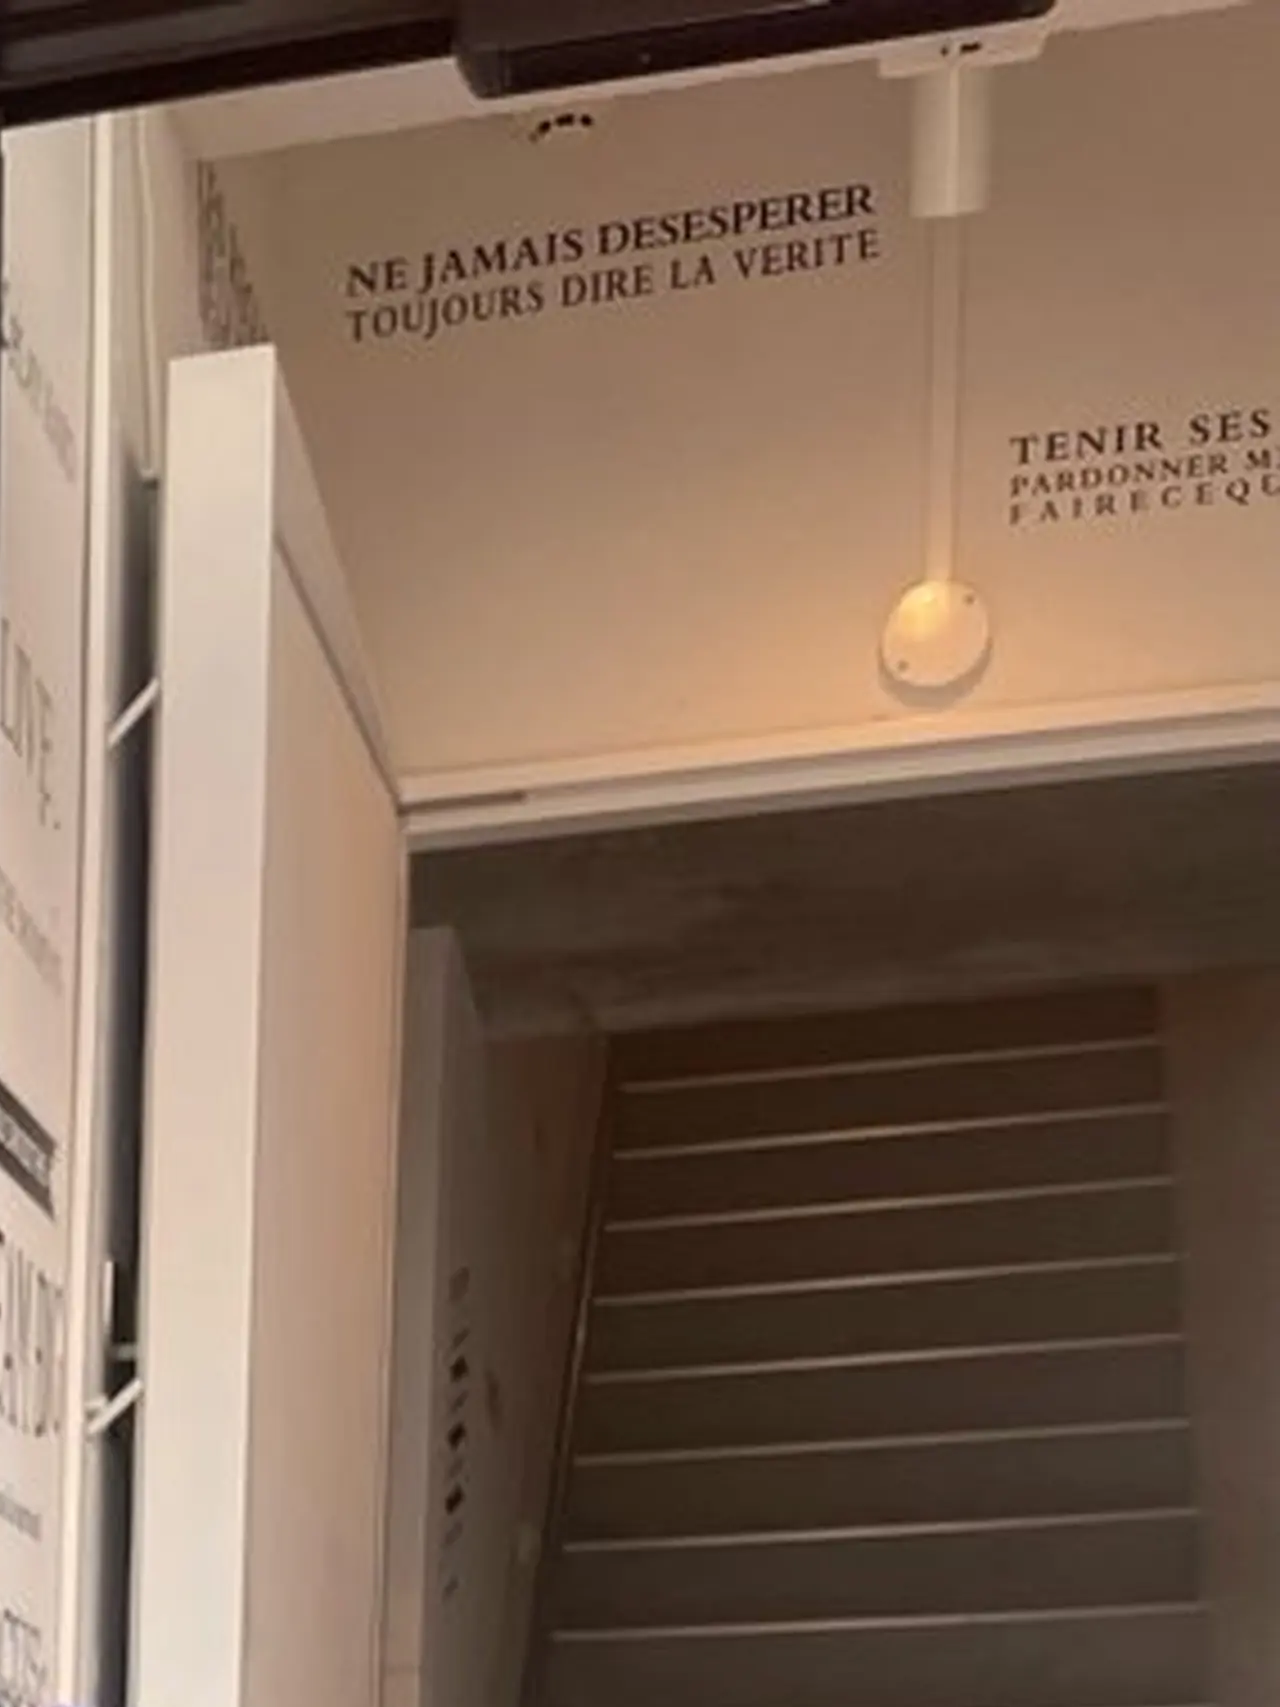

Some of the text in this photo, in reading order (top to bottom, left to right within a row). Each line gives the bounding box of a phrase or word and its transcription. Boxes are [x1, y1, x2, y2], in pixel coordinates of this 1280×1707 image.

[346, 183, 876, 298] NE JAMAIS DESESPERER
[345, 228, 880, 342] TOUJOURS DIRE LA VERITE
[1009, 408, 1271, 465] TENIR SES
[1009, 447, 1280, 498] PARDONNER M
